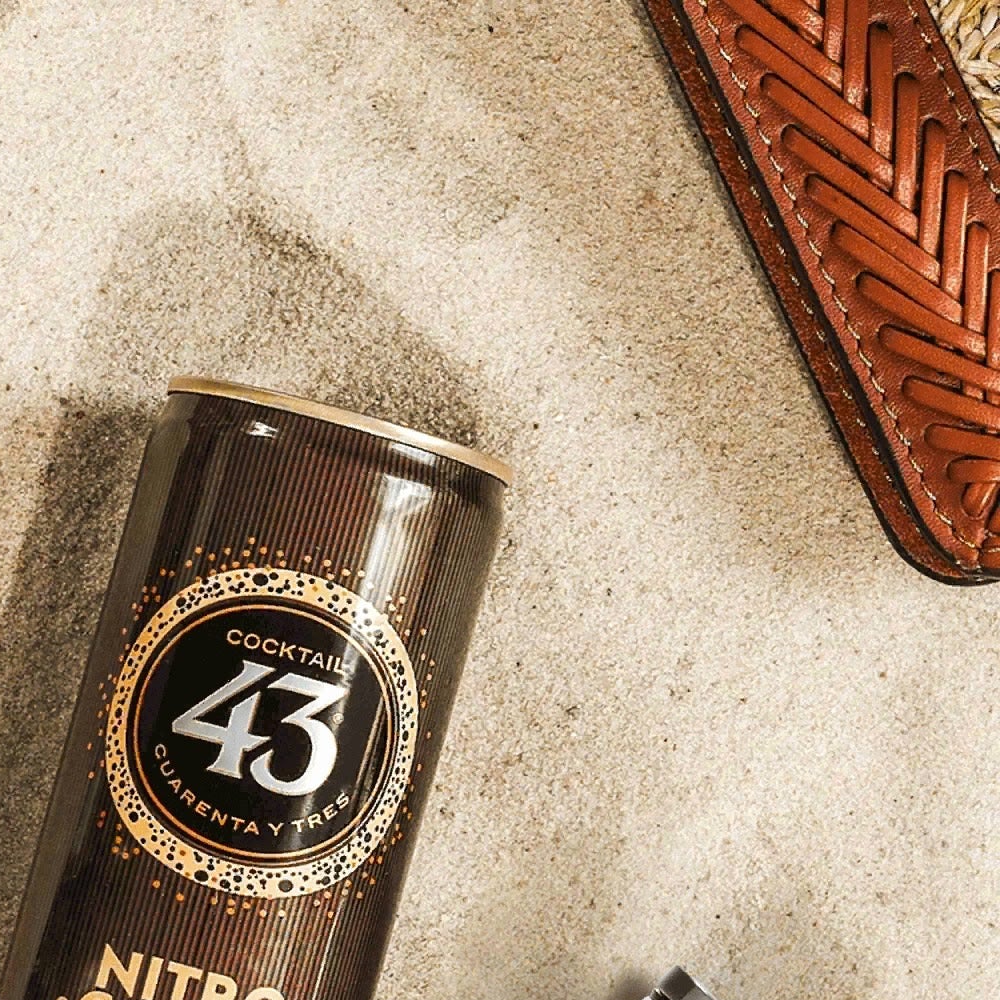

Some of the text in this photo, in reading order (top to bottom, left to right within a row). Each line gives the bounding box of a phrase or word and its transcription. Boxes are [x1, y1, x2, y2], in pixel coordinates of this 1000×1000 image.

[226, 629, 346, 674] COCKTAIL
[172, 659, 351, 797] 43
[154, 743, 350, 837] CUARENTA Y TRES
